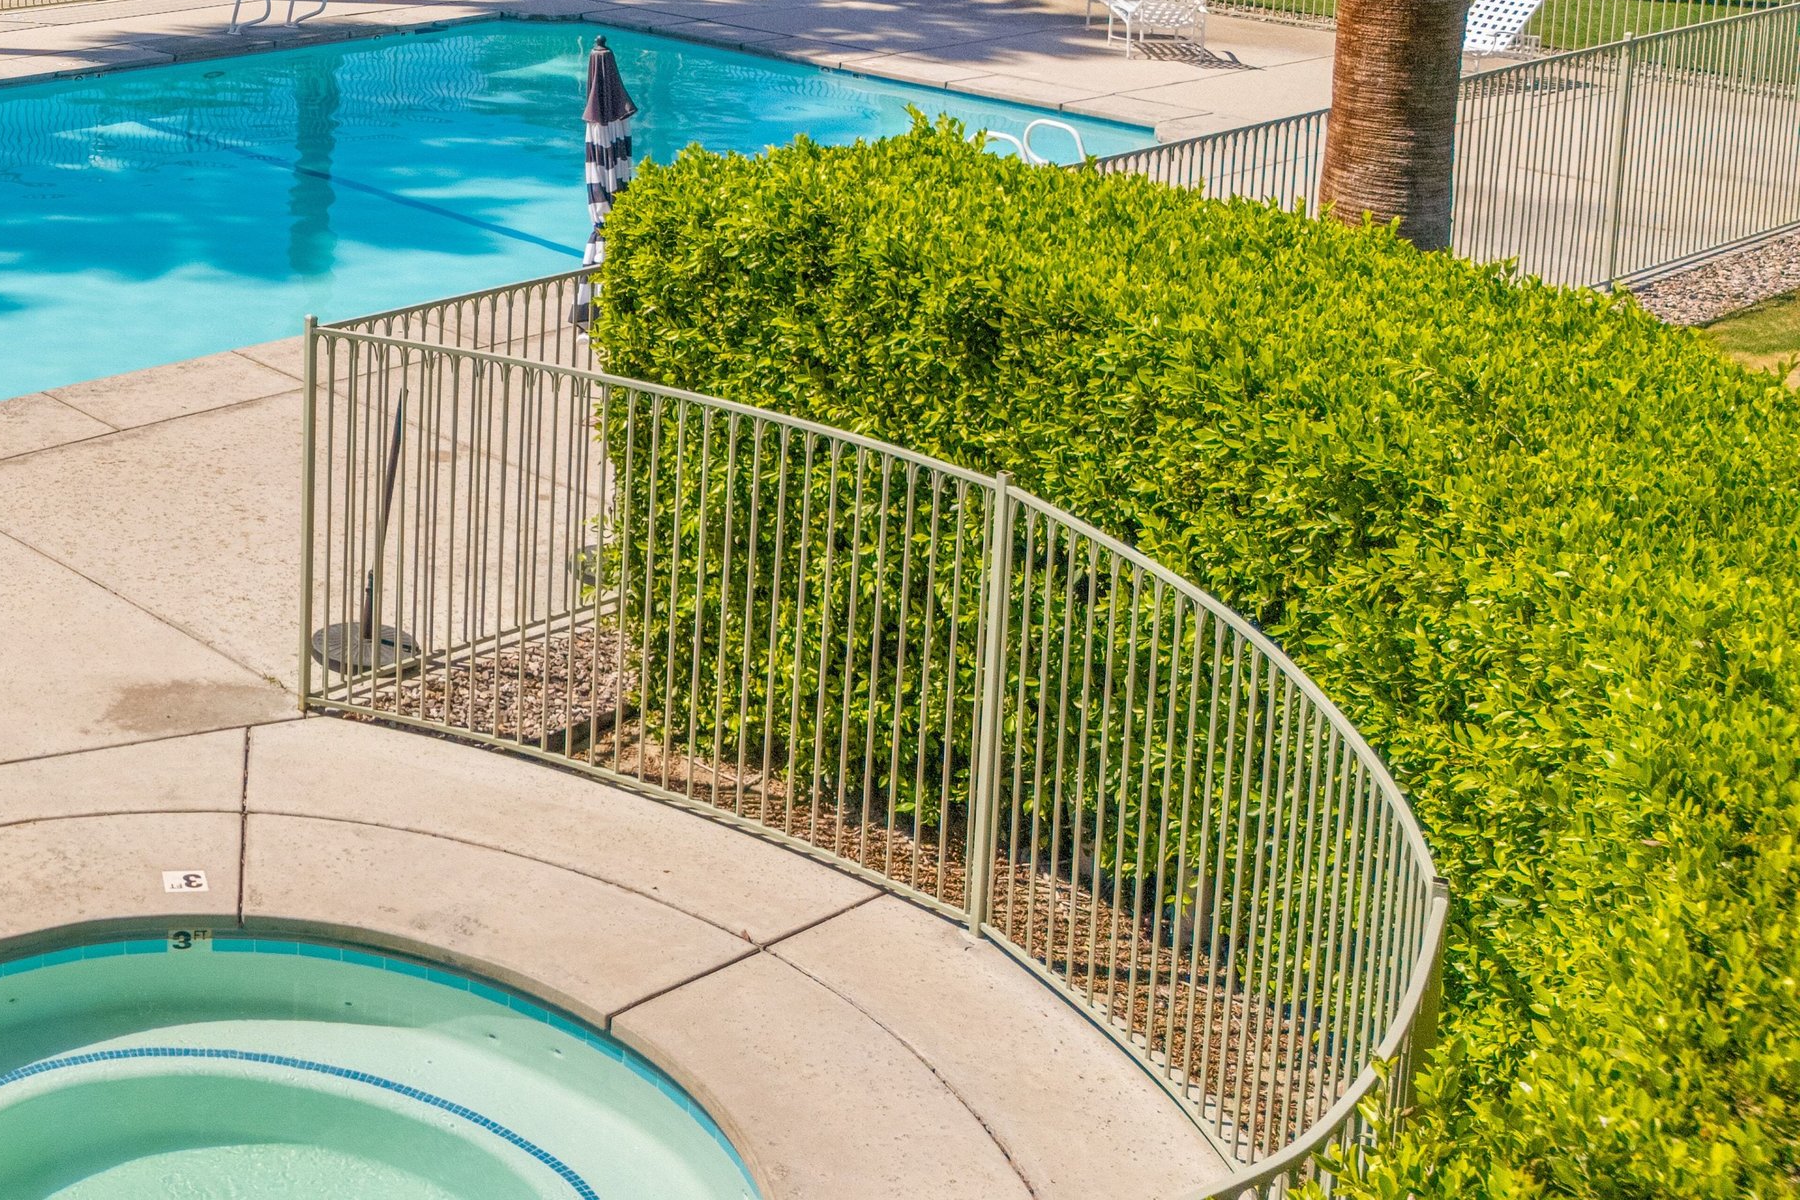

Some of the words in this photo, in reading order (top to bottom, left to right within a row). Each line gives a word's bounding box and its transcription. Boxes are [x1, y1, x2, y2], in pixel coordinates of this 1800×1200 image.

[183, 874, 203, 888] 3
[172, 931, 192, 949] 3
[194, 930, 207, 940] FT
